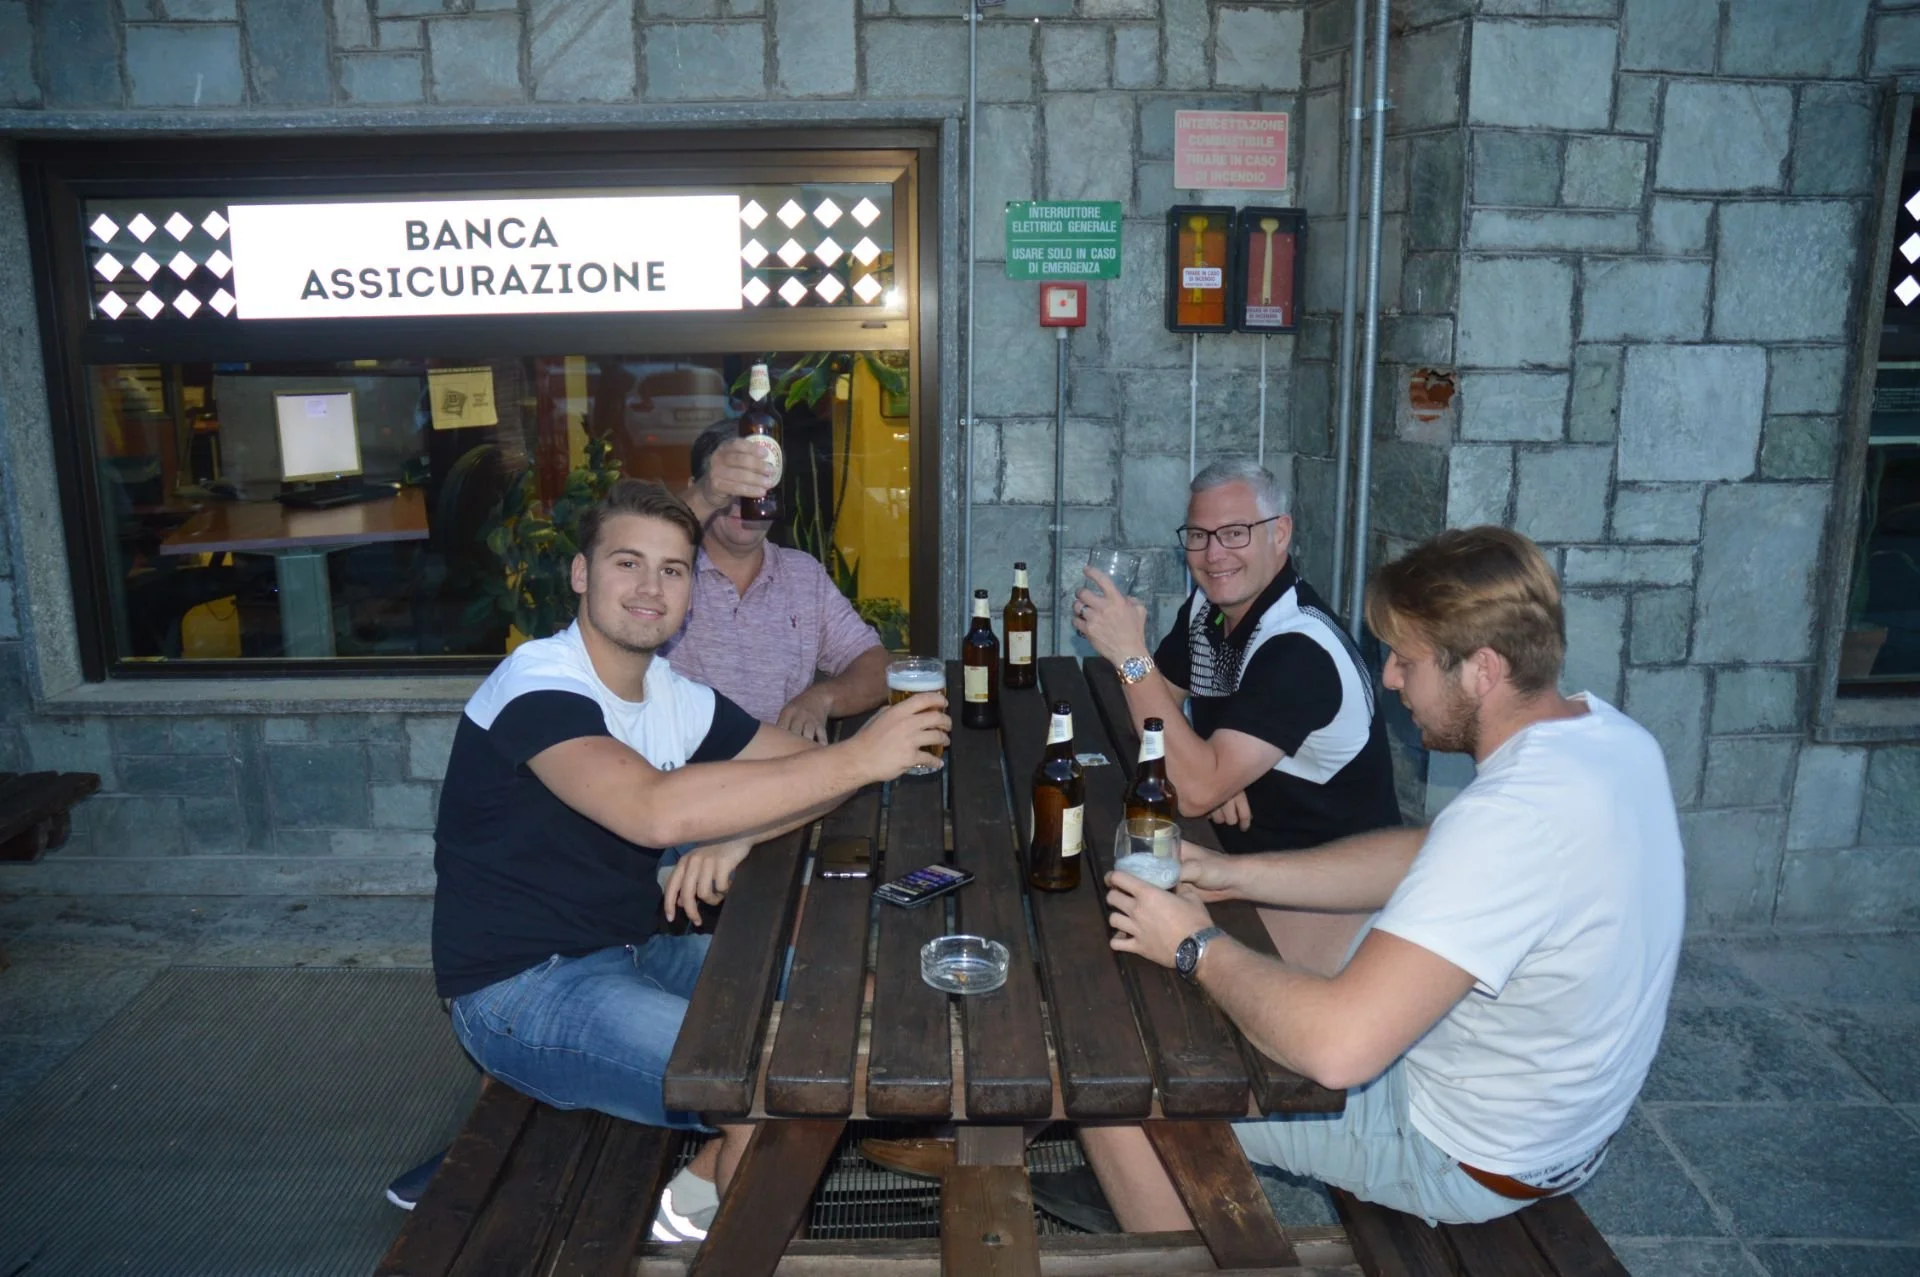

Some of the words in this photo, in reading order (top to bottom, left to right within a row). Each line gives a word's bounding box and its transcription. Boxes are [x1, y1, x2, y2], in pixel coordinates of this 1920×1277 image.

[1179, 117, 1285, 131] INTERCETTAZIONE
[1189, 134, 1275, 148] COMBUSTIBILE
[1186, 153, 1227, 166] TIRARE
[1230, 154, 1242, 166] IN
[1245, 155, 1277, 167] CASO
[1210, 171, 1266, 183] INCENDIO
[1028, 206, 1101, 218] INTERRUTTORE
[405, 216, 559, 251] BANCA
[1012, 221, 1062, 233] ELETTRICO
[1067, 221, 1117, 233] GENERALE
[1012, 247, 1044, 260] USARE
[1047, 247, 1072, 260] SOLO
[1076, 248, 1086, 259] IN
[1090, 247, 1117, 260] CASO
[1028, 262, 1039, 273] DI
[1042, 261, 1101, 274] EMERGENZA
[300, 261, 666, 300] ASSICURAZIONE
